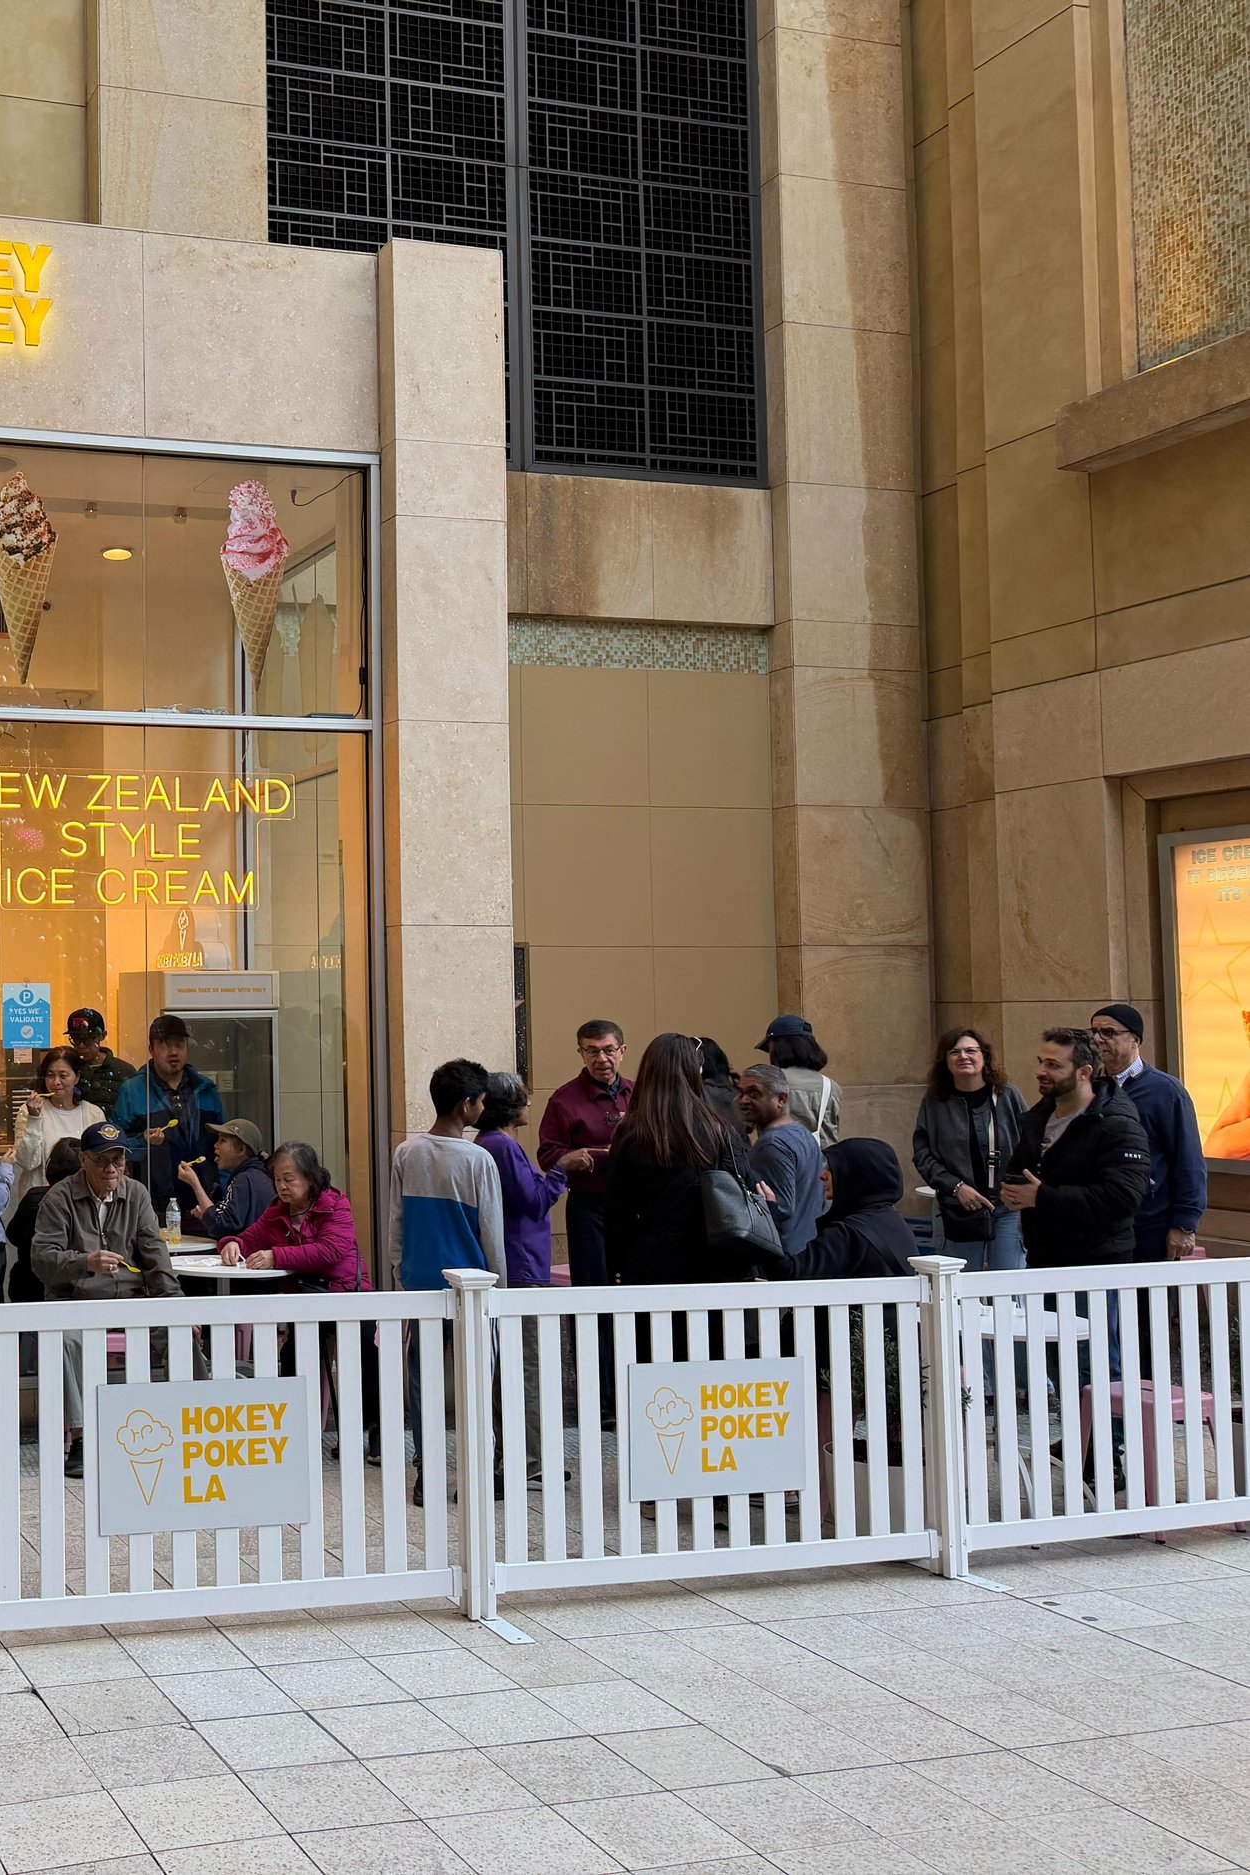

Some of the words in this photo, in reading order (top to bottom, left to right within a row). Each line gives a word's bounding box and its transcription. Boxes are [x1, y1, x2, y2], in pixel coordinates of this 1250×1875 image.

[86, 774, 292, 815] ZEALAND
[60, 821, 202, 860] STYLE
[1191, 848, 1216, 864] ICE
[6, 868, 76, 906] ICE
[96, 869, 254, 906] CREAM
[23, 992, 31, 1002] P
[700, 1381, 790, 1411] HOKEY
[181, 1402, 288, 1435] HOKEY
[701, 1411, 790, 1442] POKEY
[182, 1436, 289, 1469] POKEY
[701, 1446, 738, 1473] LA
[183, 1474, 226, 1504] LA
